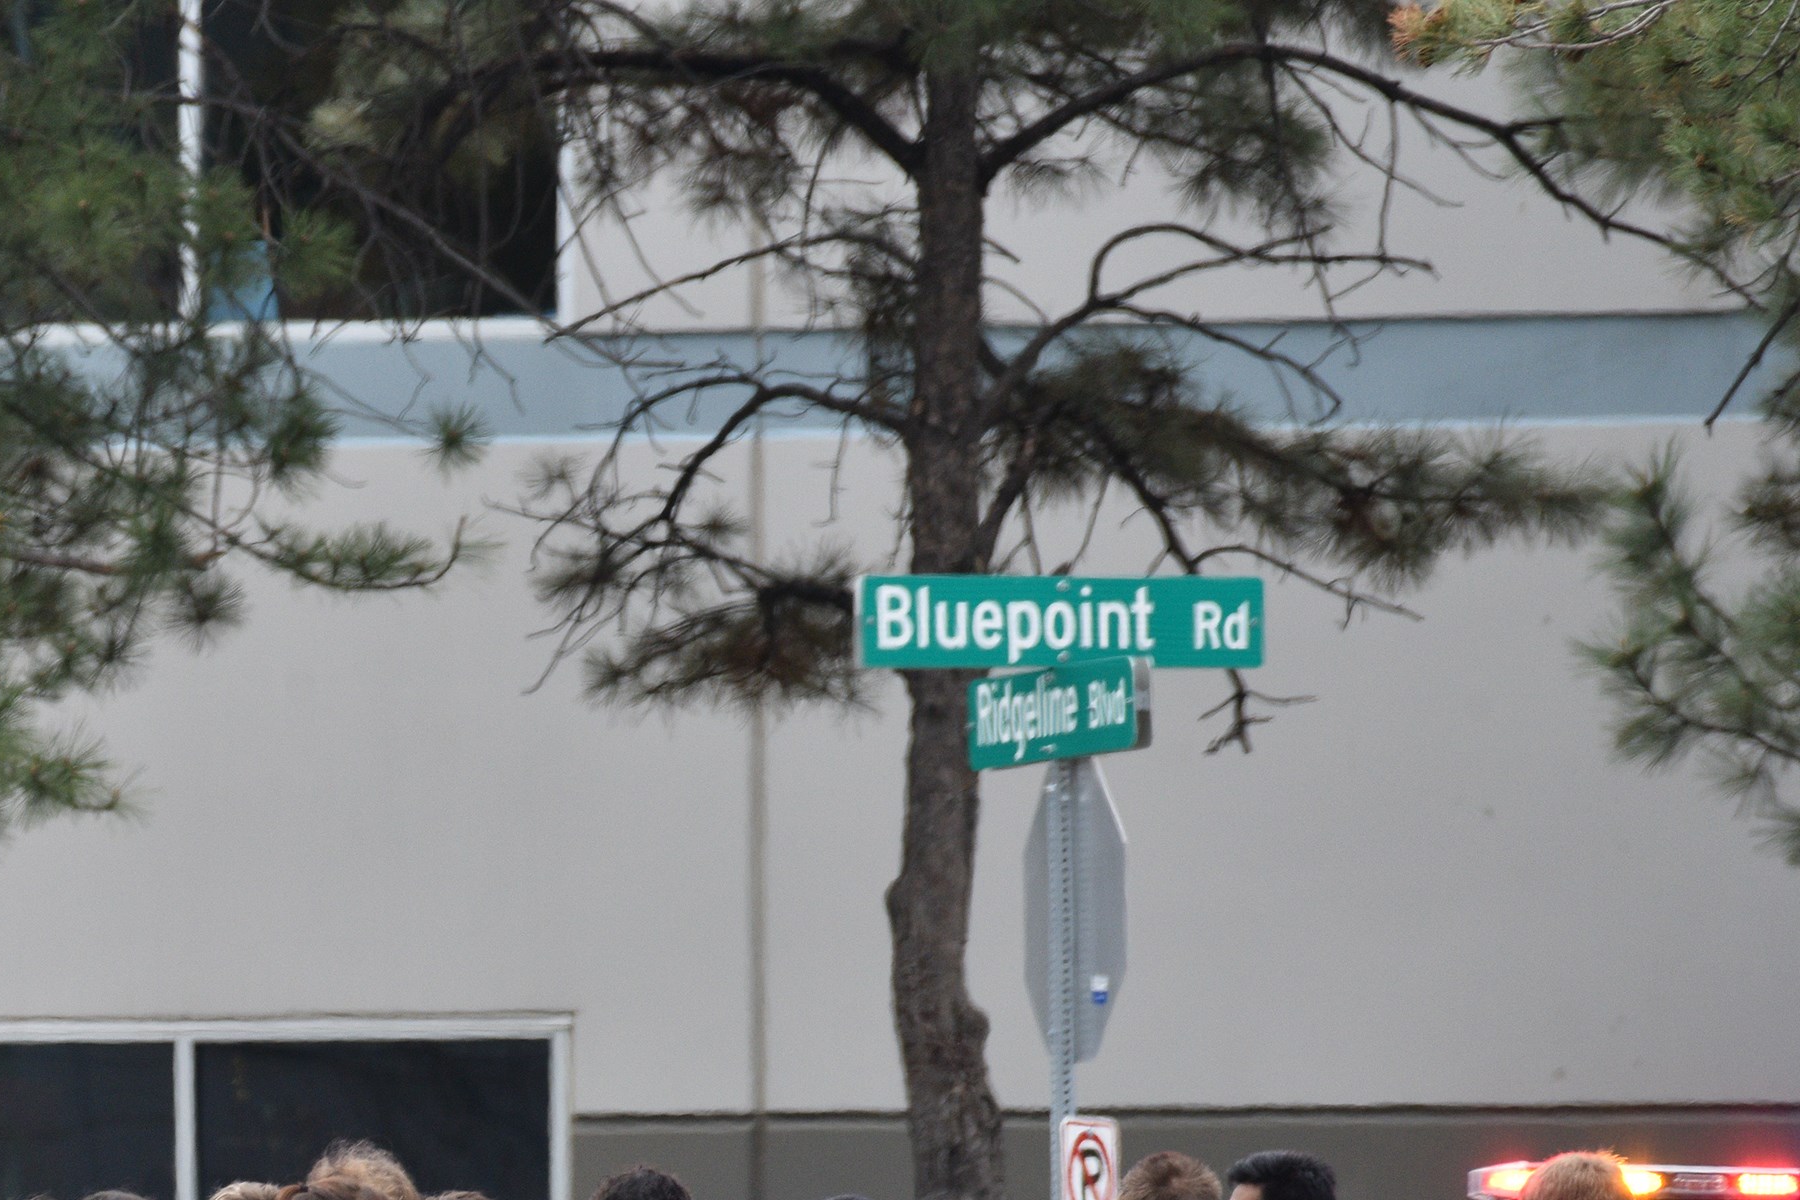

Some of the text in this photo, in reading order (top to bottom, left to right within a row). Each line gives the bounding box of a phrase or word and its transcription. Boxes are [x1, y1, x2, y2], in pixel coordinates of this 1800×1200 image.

[874, 584, 1251, 664] Bluepoint Rd
[976, 675, 1126, 762] Ridgeline Blvd
